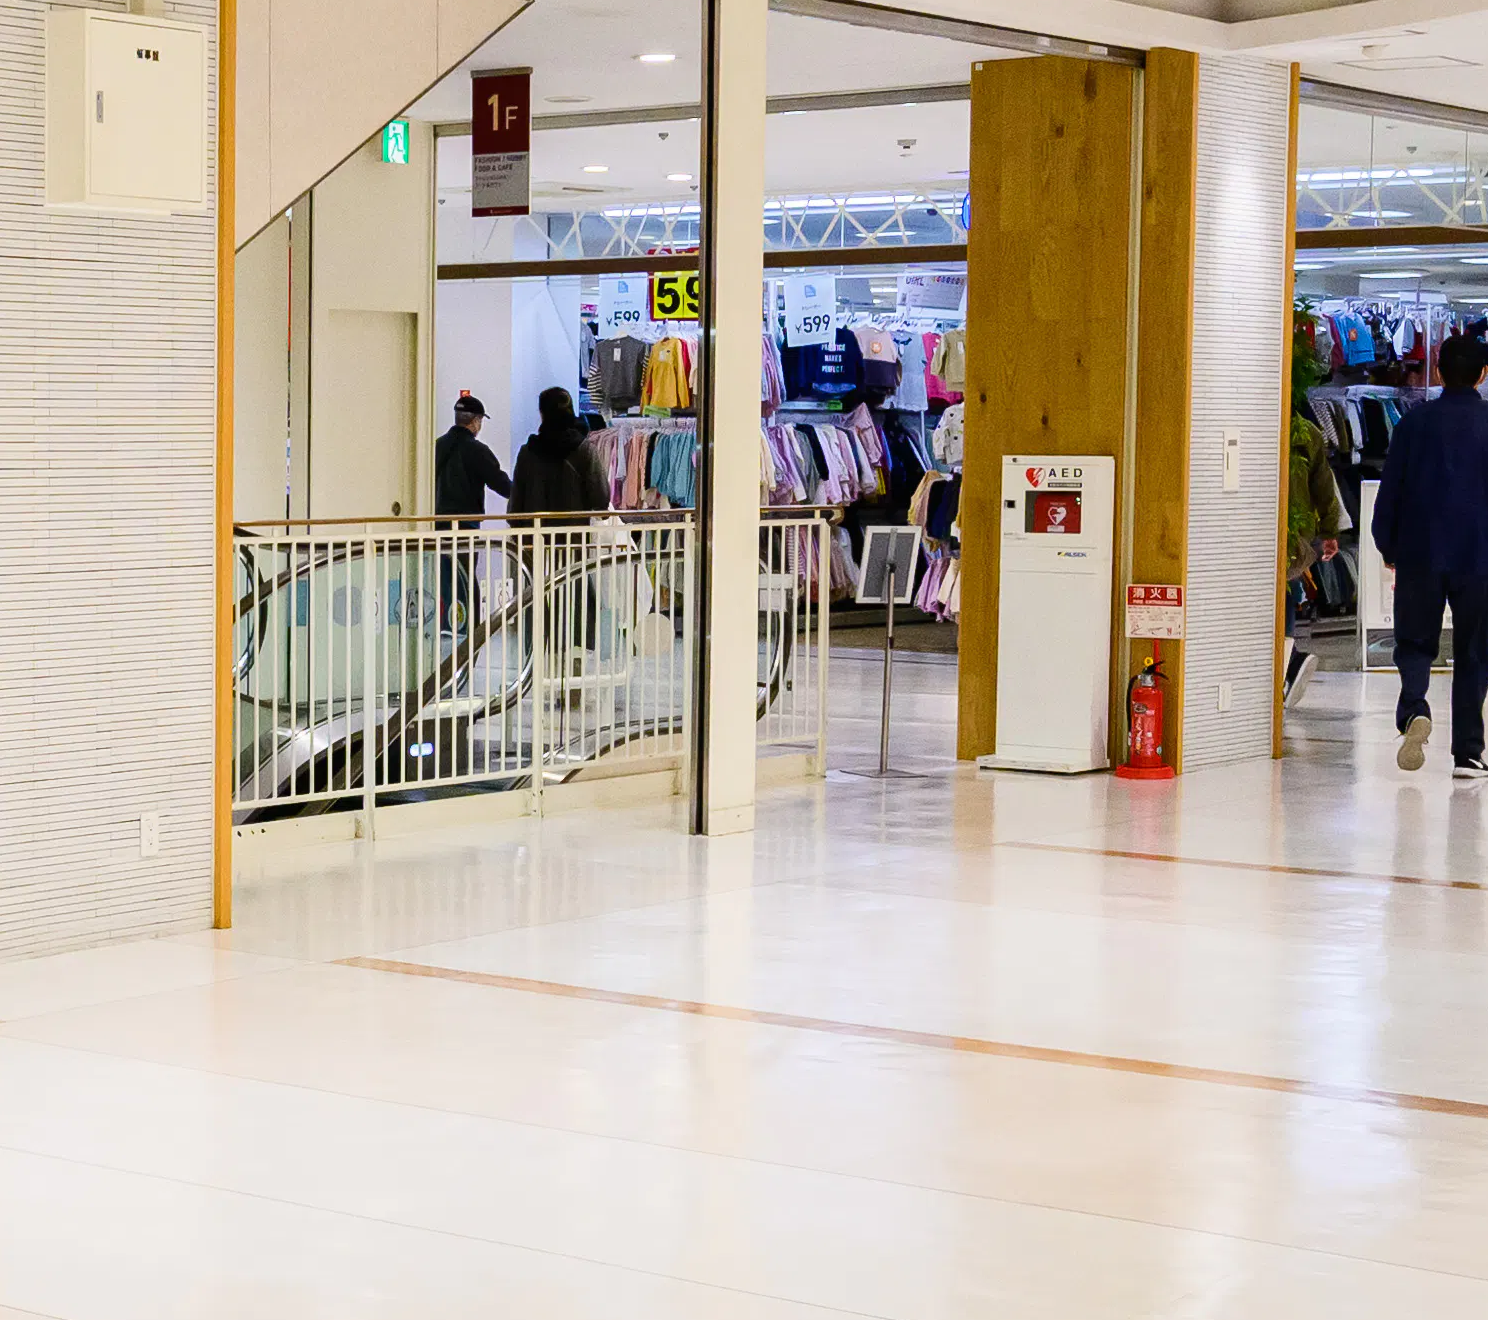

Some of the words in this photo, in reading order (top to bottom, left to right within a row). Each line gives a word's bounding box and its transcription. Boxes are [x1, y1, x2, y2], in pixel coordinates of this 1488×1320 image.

[487, 94, 519, 131] 1F
[1048, 468, 1083, 478] AED
[1132, 587, 1178, 600] 消火器
